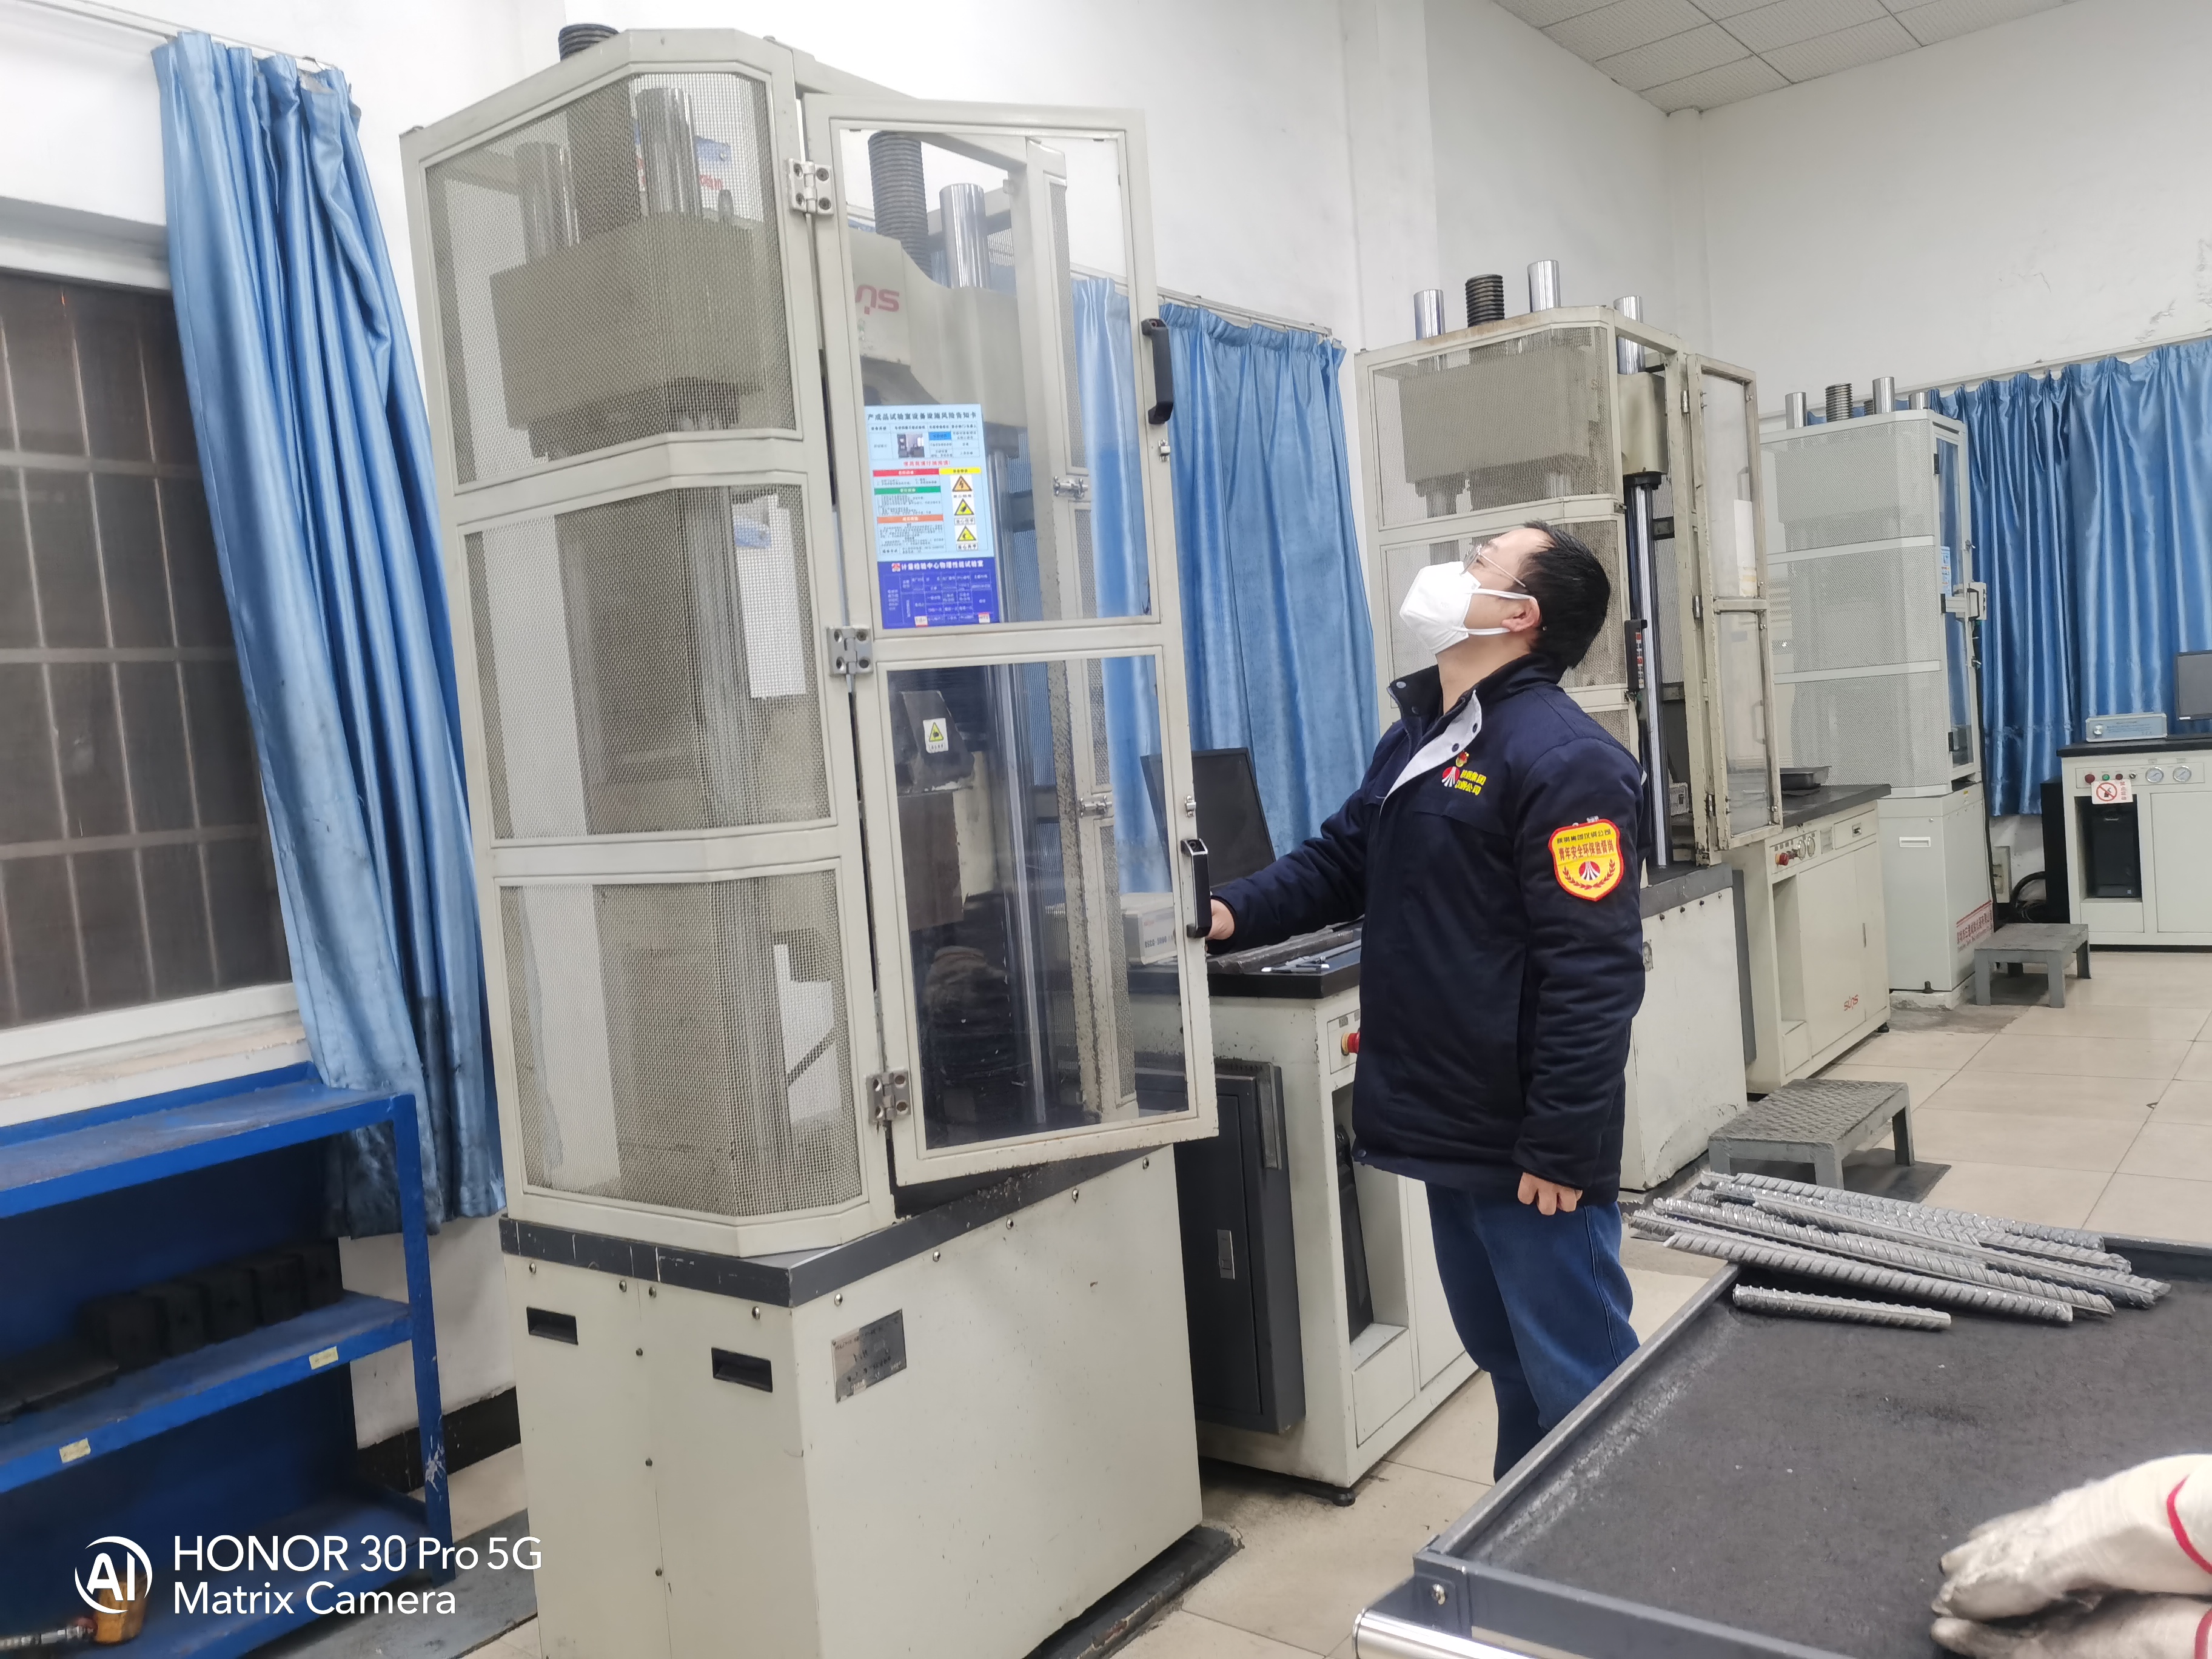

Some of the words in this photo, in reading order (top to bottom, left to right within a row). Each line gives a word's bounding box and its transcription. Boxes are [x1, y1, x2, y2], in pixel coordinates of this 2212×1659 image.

[1558, 839, 1614, 861] 青年安全环保监督岗
